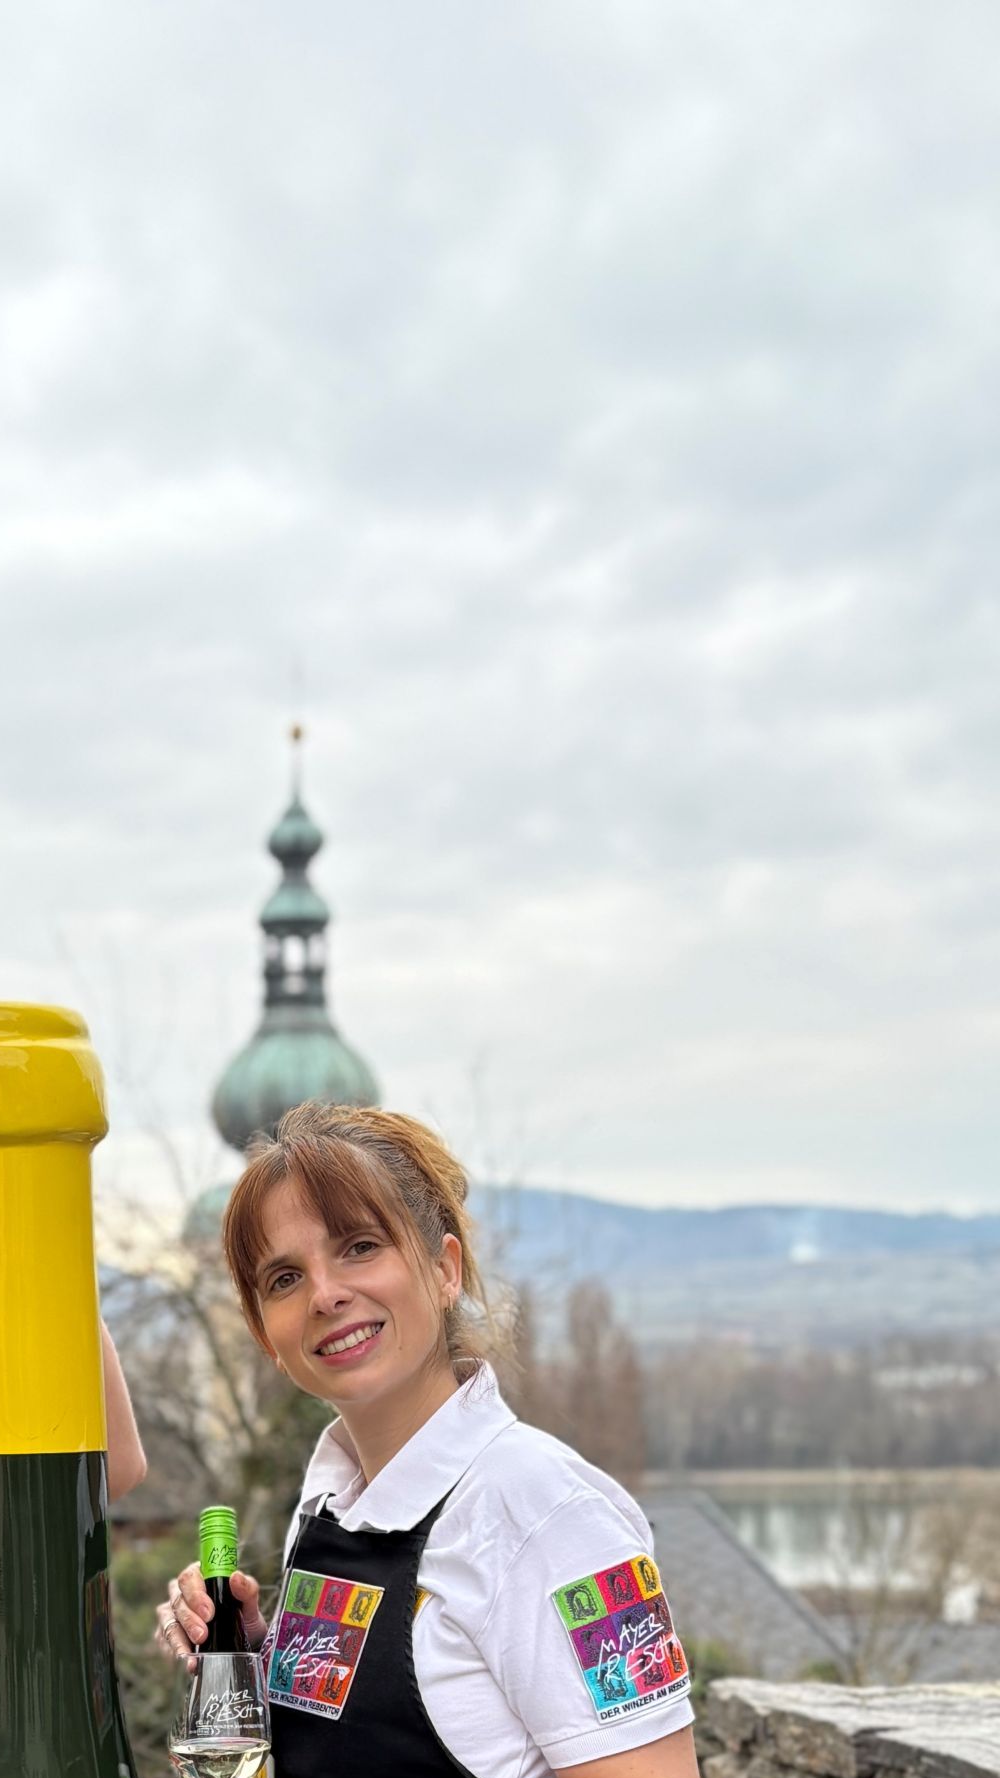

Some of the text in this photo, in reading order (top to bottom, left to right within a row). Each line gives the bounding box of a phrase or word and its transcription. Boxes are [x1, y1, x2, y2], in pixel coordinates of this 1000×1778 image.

[208, 1545, 237, 1563] MAYE
[280, 1630, 341, 1662] MAYER
[598, 1613, 665, 1680] MAYER
[604, 1634, 673, 1682] RESCH
[281, 1647, 337, 1679] RESCH
[202, 1689, 254, 1715] MAYER
[206, 1702, 254, 1722] RESCH
[600, 1707, 621, 1720] DER
[622, 1694, 655, 1713] WINZER
[656, 1688, 667, 1698] AM
